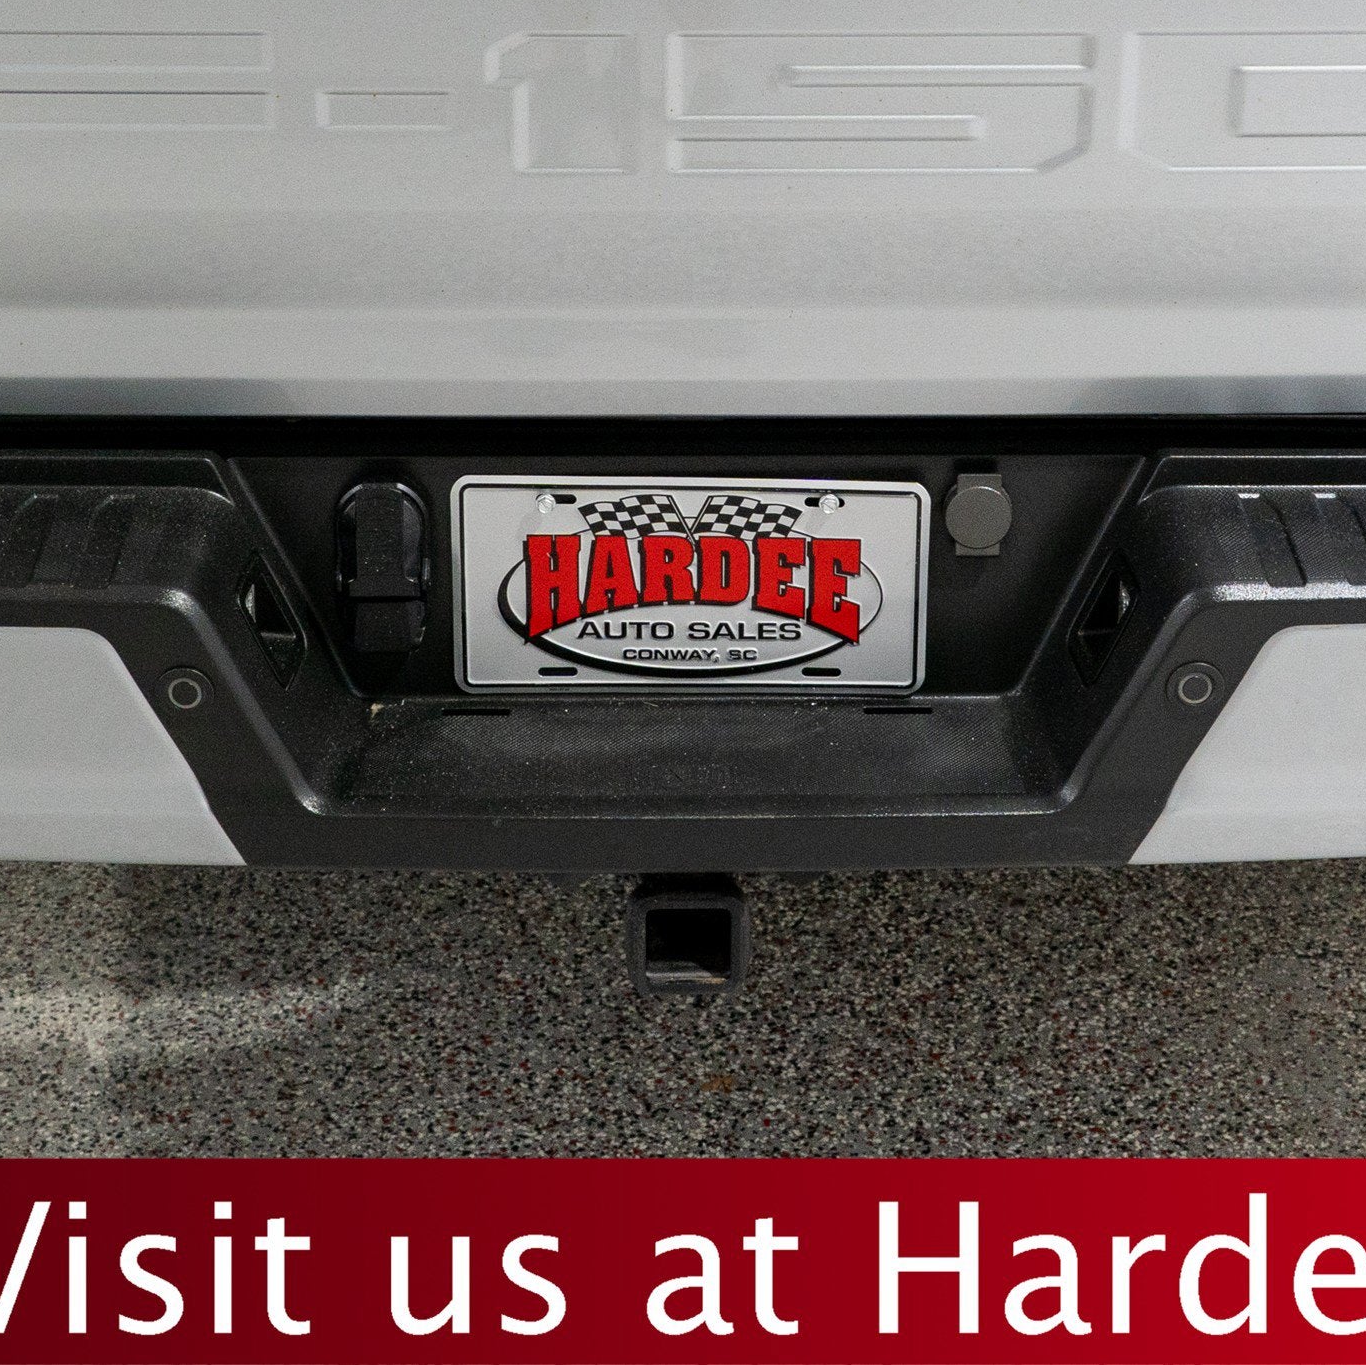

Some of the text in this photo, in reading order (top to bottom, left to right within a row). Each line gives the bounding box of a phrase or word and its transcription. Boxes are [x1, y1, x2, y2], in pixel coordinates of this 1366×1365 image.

[524, 534, 861, 644] HARDEE
[577, 620, 802, 641] AUTO SALES
[622, 648, 758, 663] CONWAY, SC
